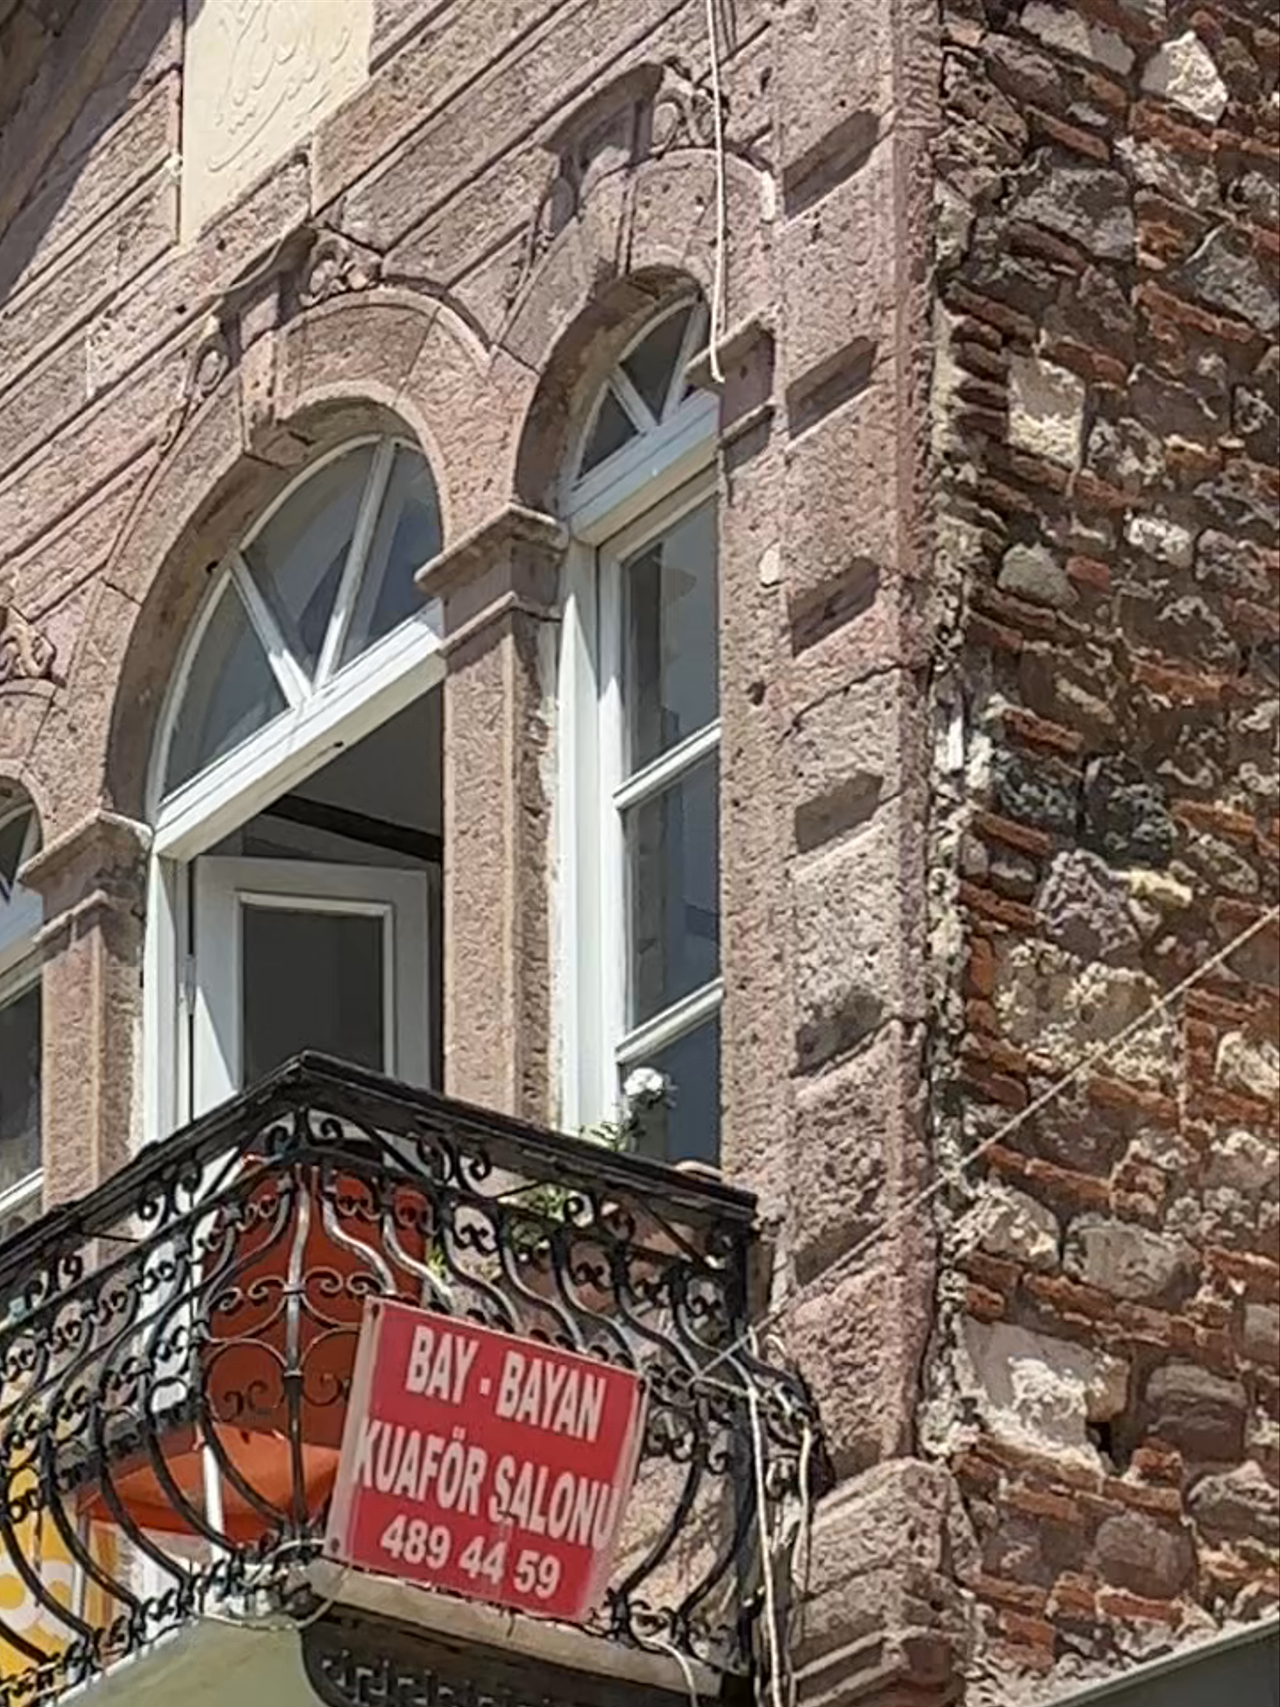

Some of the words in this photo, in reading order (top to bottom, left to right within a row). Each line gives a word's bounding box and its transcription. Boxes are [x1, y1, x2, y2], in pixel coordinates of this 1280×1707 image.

[406, 1325, 479, 1404] BAY
[495, 1351, 607, 1443] BAYAN
[354, 1417, 488, 1517] KUAFÖR
[488, 1455, 621, 1549] SALONU
[380, 1514, 451, 1569] 489
[459, 1536, 507, 1585] 44
[513, 1549, 561, 1599] 59
